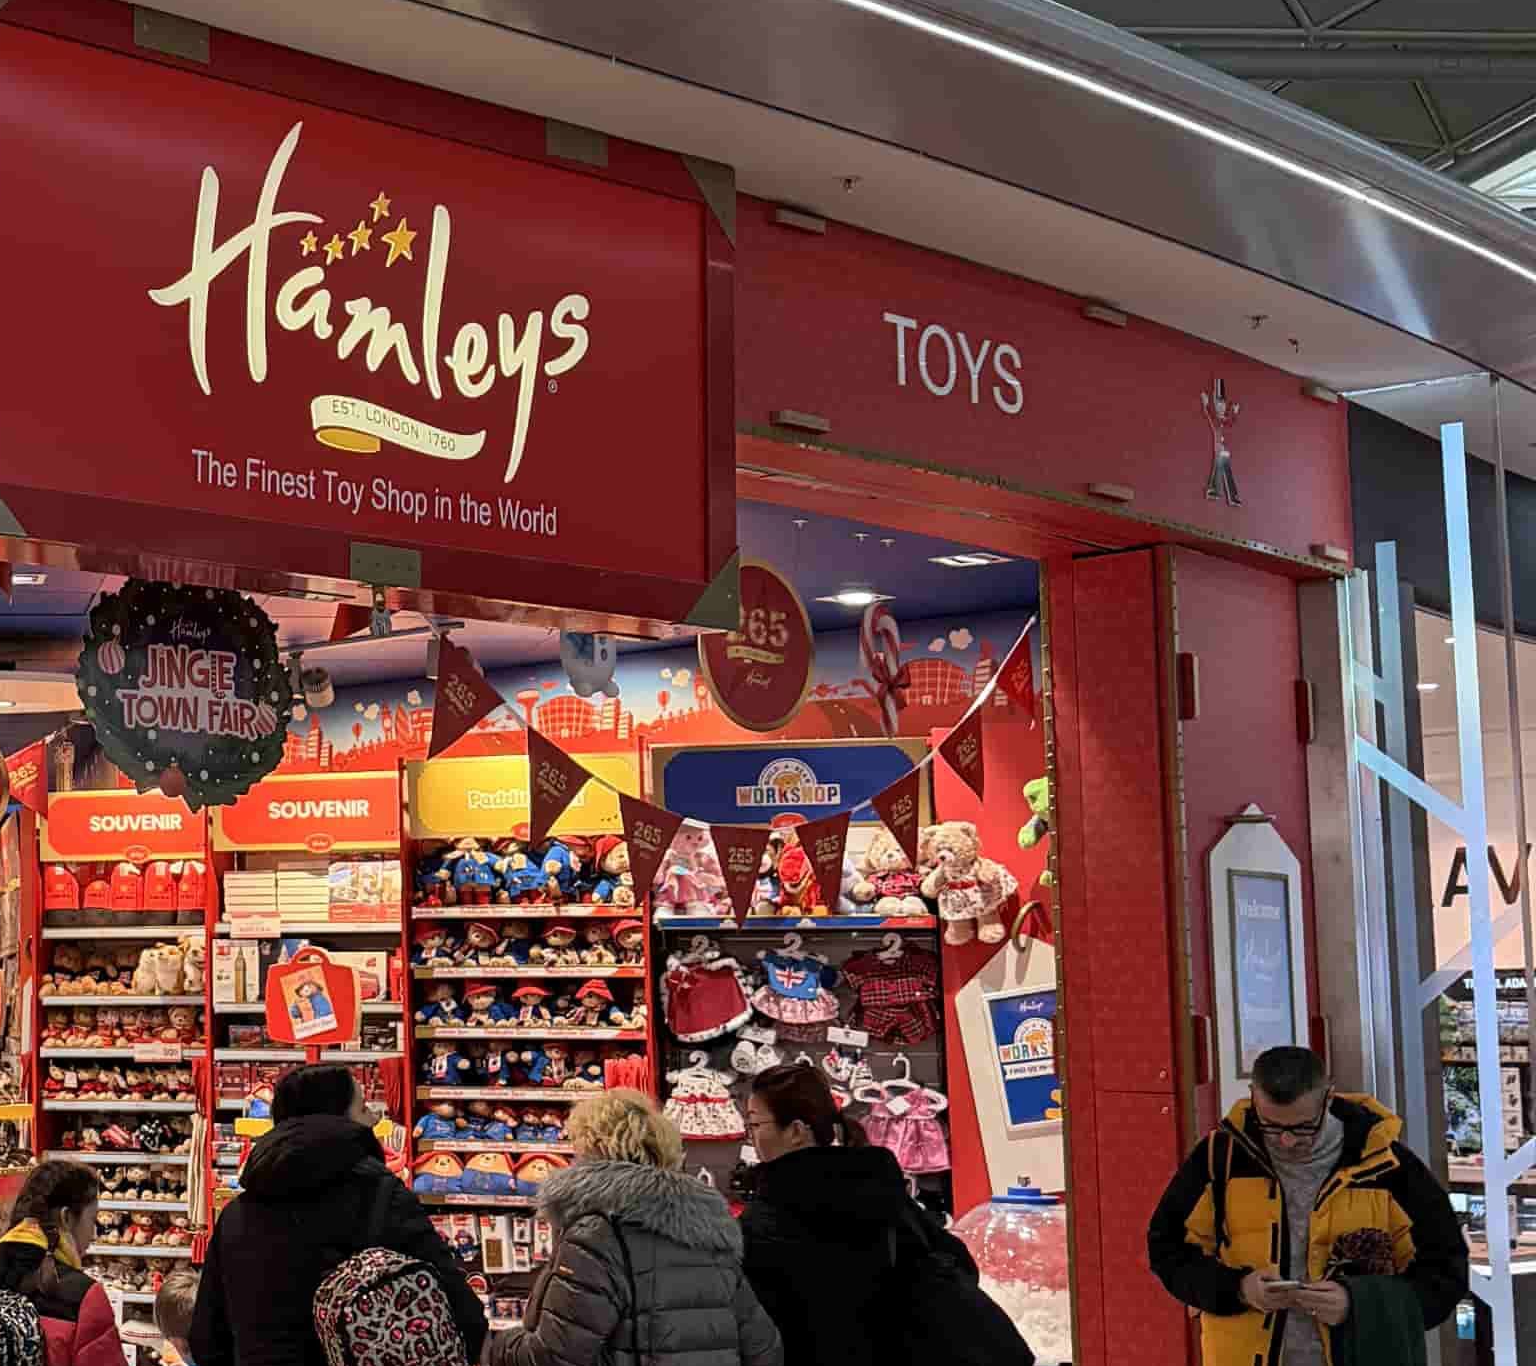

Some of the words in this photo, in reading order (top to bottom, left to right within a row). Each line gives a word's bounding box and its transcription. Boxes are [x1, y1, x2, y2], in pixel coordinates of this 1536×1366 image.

[148, 121, 590, 483] Hamleys
[883, 312, 1024, 414] TOYS
[332, 399, 360, 420] EST.
[366, 407, 419, 439] LONDON
[428, 430, 456, 452] 1760
[192, 449, 237, 487] The
[246, 459, 315, 500] Finest
[323, 469, 364, 515] Toy
[372, 478, 427, 521] Shop
[434, 488, 453, 520] in
[459, 493, 491, 525] the
[498, 499, 557, 535] World
[121, 689, 199, 733] TOWN
[9, 762, 38, 784] 265
[736, 784, 839, 805] WORKSHOP
[268, 800, 370, 820] SOUVENIR
[890, 802, 913, 822] 265
[89, 813, 182, 832] SOUVENIR
[633, 821, 663, 843] 265
[728, 847, 753, 863] 265
[816, 836, 839, 856] 265
